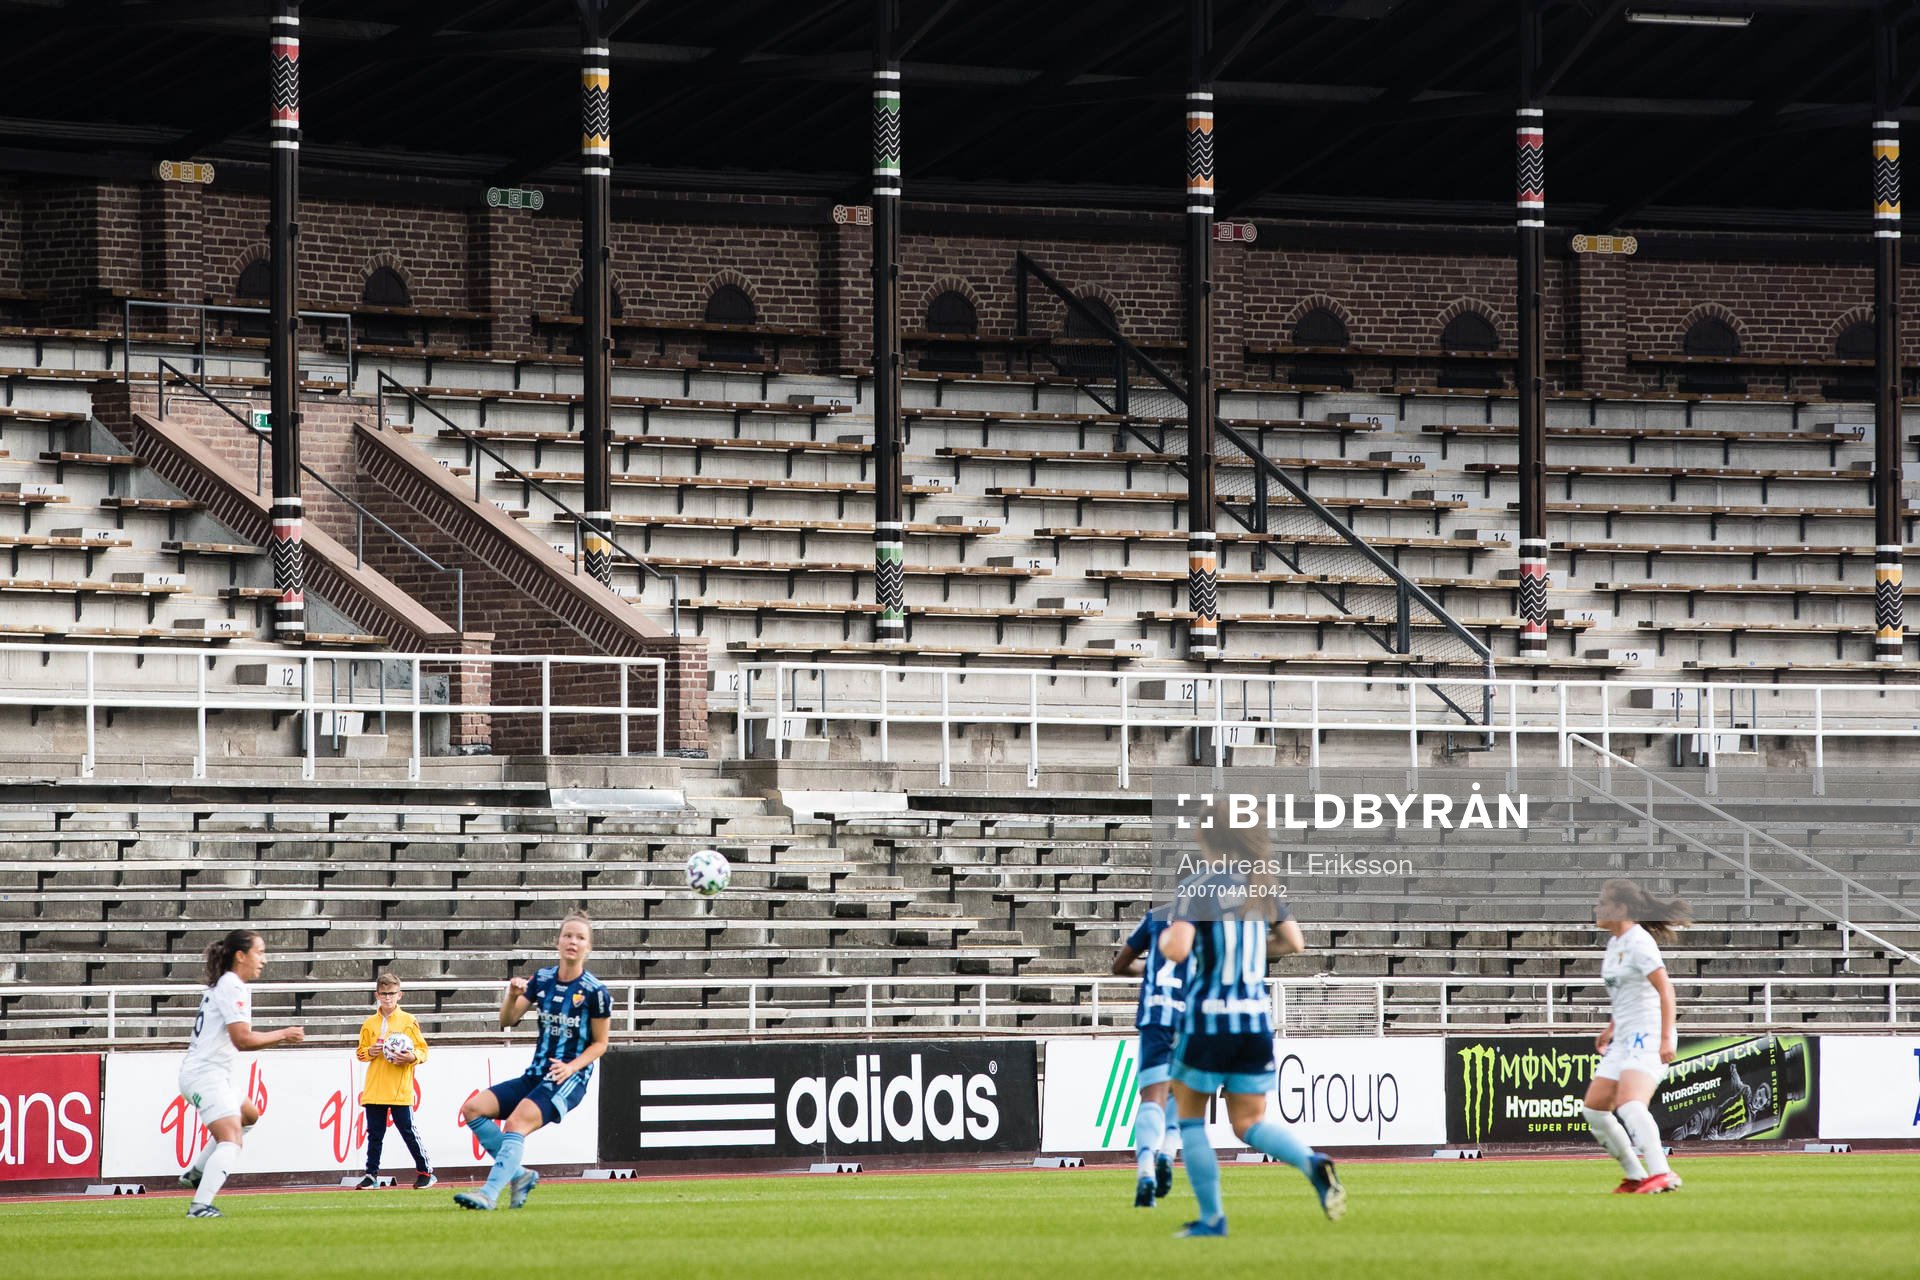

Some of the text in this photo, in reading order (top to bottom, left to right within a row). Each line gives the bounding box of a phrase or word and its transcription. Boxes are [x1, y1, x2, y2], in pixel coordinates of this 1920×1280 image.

[283, 668, 294, 686] 12
[729, 674, 739, 691] 12
[1182, 683, 1193, 699] 12
[339, 715, 348, 732] 11
[784, 720, 792, 737] 11
[1230, 727, 1239, 743] 11
[785, 1053, 999, 1145] adidas
[1278, 1053, 1399, 1140] Group
[1668, 1092, 1717, 1113] SUPER FUEL
[1505, 1094, 1584, 1118] HYDROSP
[1528, 1122, 1562, 1132] SUPER
